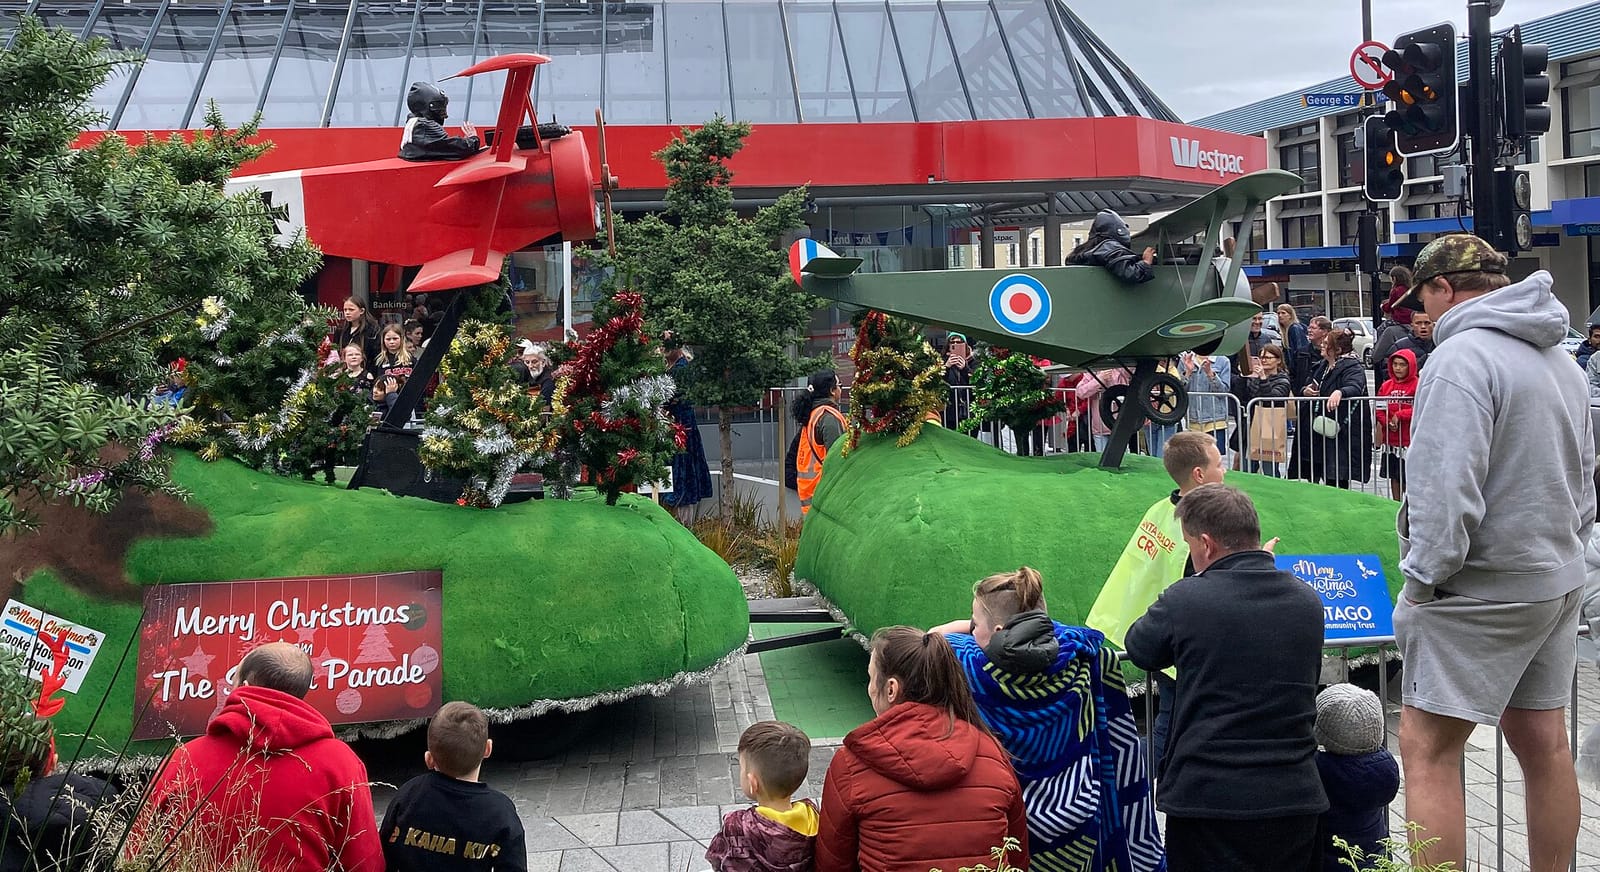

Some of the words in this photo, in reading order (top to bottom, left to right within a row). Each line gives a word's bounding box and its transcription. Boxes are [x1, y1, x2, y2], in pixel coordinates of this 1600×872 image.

[1306, 95, 1341, 106] George
[1343, 95, 1354, 105] St
[1170, 136, 1244, 178] Westpac
[372, 301, 407, 309] Banking
[1293, 560, 1336, 578] Merry
[173, 606, 255, 641] Merry
[266, 597, 411, 632] Christmas
[1323, 605, 1372, 622] TAGO
[43, 619, 88, 645] Chrimas
[1325, 622, 1357, 631] ommunity
[1357, 621, 1376, 630] Trust
[23, 656, 50, 676] roup
[35, 641, 84, 671] Howson
[152, 666, 215, 702] The
[320, 653, 427, 691] Parade
[404, 826, 457, 855] KAHA
